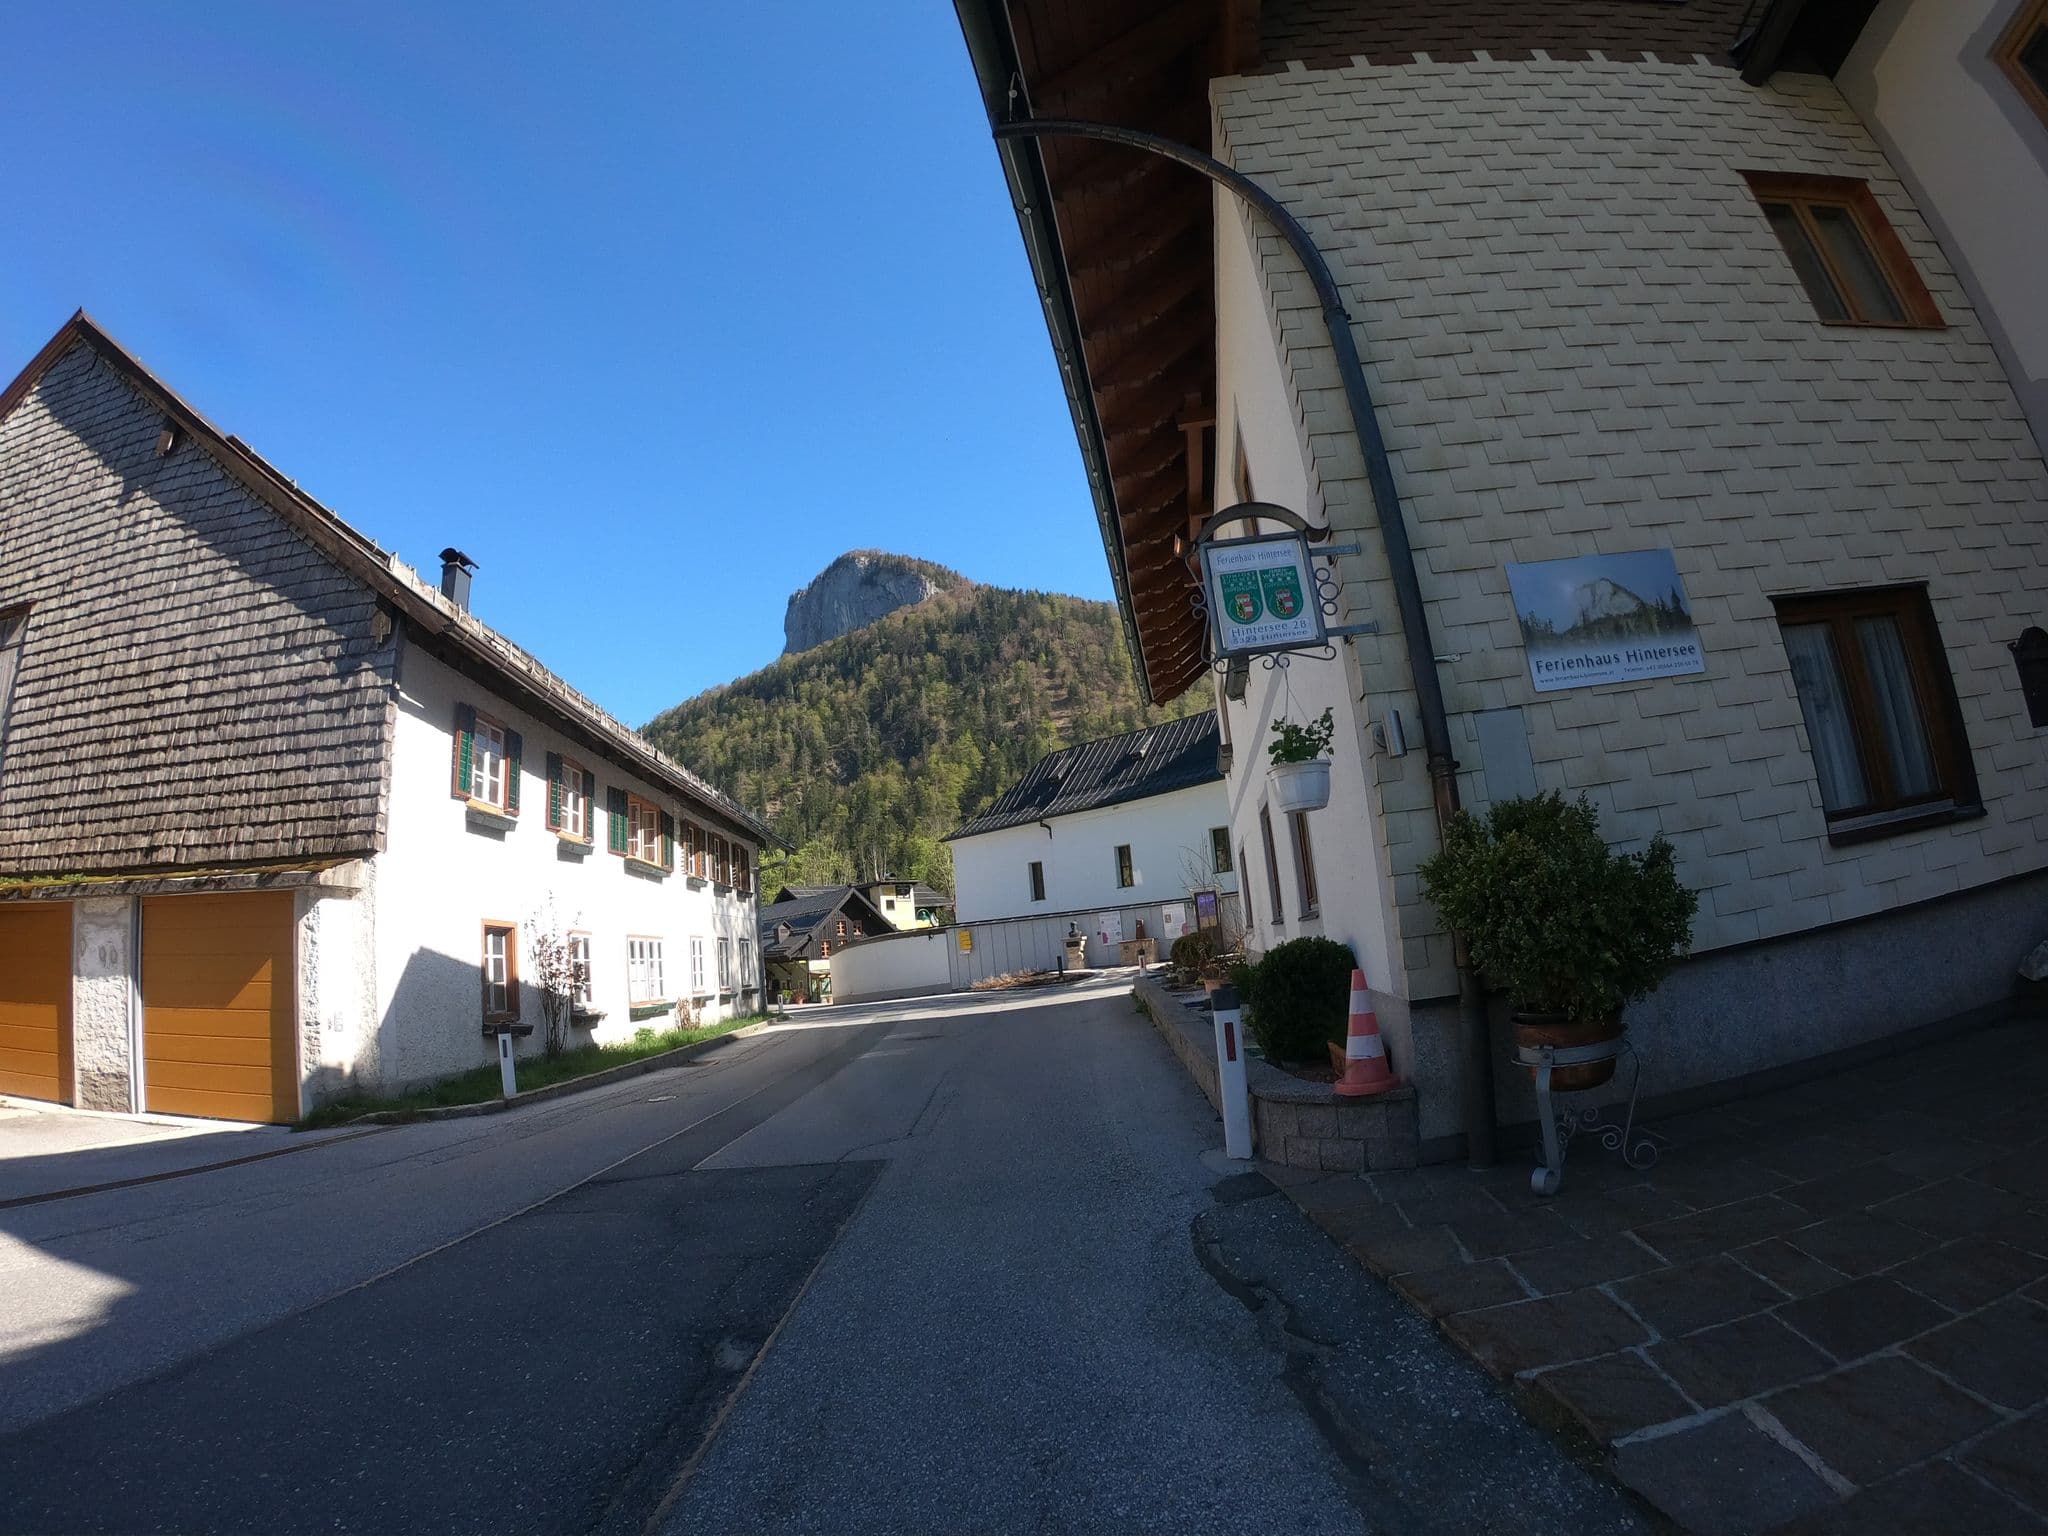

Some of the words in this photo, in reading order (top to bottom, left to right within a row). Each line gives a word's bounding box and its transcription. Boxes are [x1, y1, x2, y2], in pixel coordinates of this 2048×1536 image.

[1217, 552, 1255, 565] Ferienhaus
[1258, 549, 1291, 561] Hintersee
[1231, 623, 1288, 638] Hintersee
[1262, 630, 1308, 641] Hintersee
[1536, 653, 1620, 674] Ferienhaus
[1626, 645, 1695, 663] Hintersee
